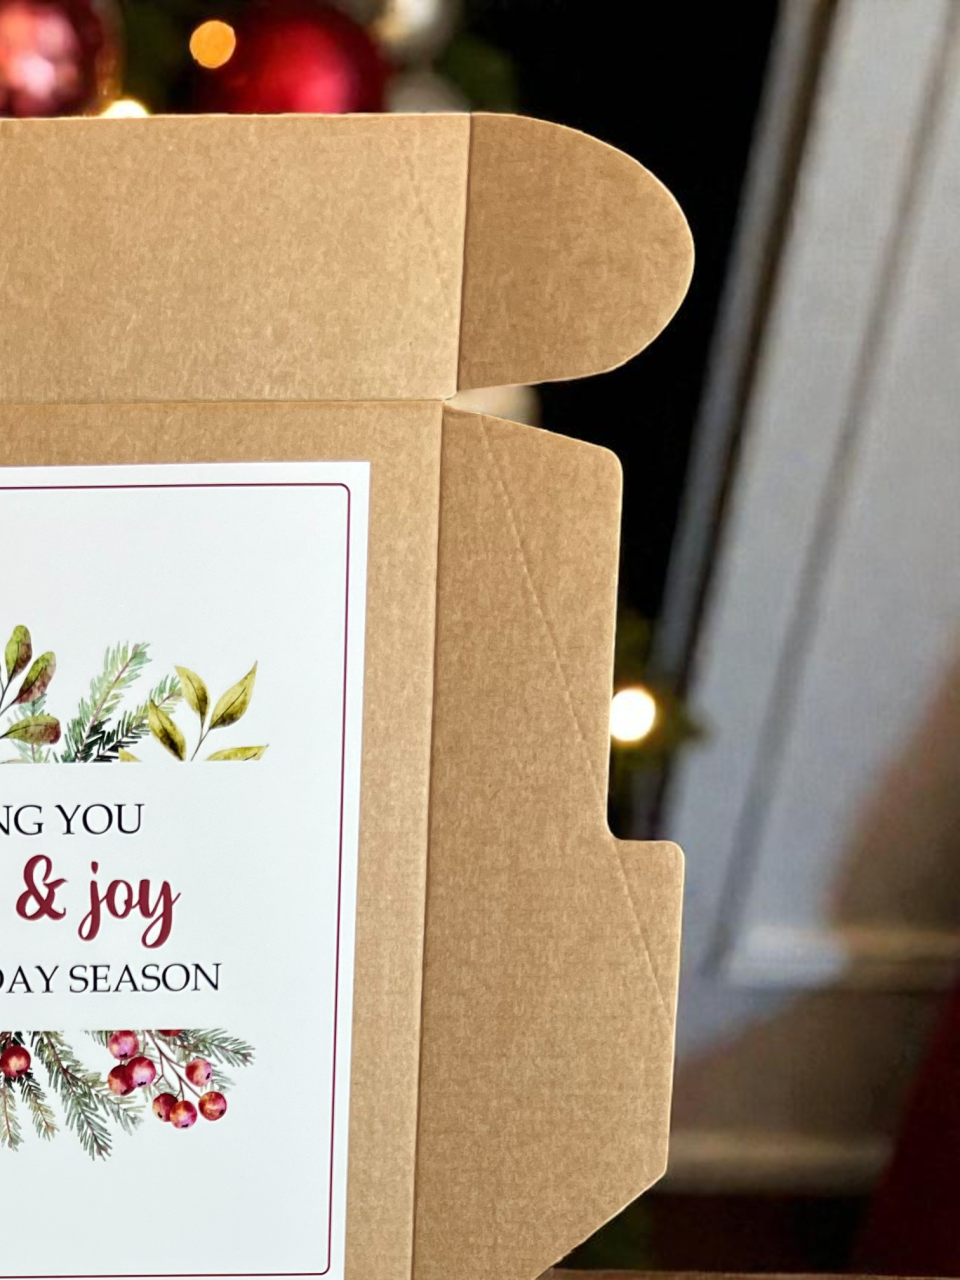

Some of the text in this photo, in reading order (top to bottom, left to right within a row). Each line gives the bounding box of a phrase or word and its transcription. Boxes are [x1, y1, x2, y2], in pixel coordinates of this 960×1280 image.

[55, 803, 145, 836] YOU
[15, 854, 68, 921] &
[77, 861, 182, 949] joy
[69, 962, 222, 993] SEASON
